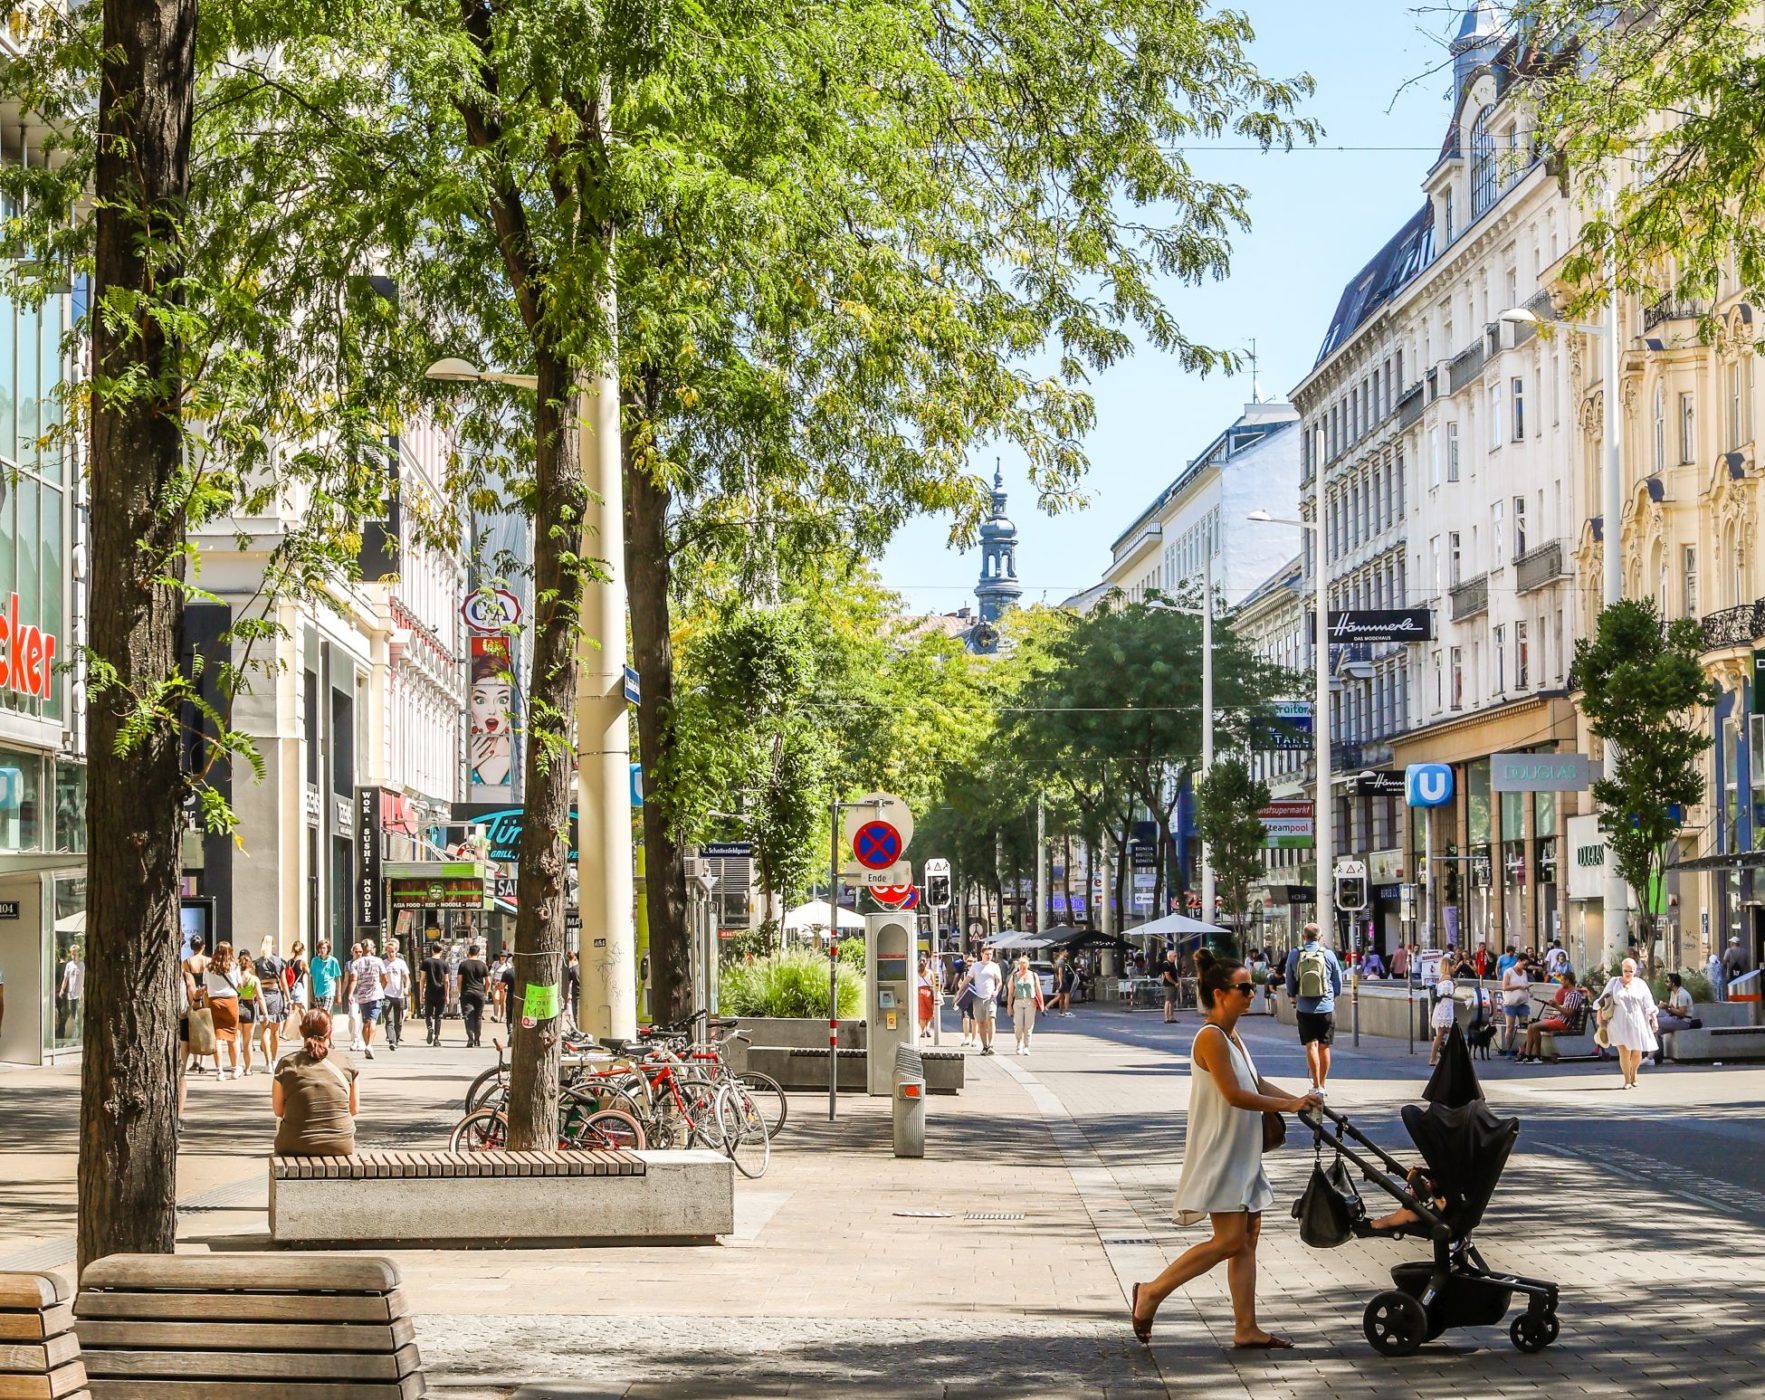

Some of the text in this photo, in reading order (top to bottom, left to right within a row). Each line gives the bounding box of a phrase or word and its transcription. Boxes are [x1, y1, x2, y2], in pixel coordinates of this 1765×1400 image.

[1504, 765, 1577, 779] DOUGLAS
[1419, 772, 1446, 801] U
[1258, 805, 1310, 816] unstsupermarkt
[362, 791, 372, 923] WOK SUSHI NOODLE
[1577, 844, 1605, 867] DOUGLAS
[868, 873, 887, 883] Ende
